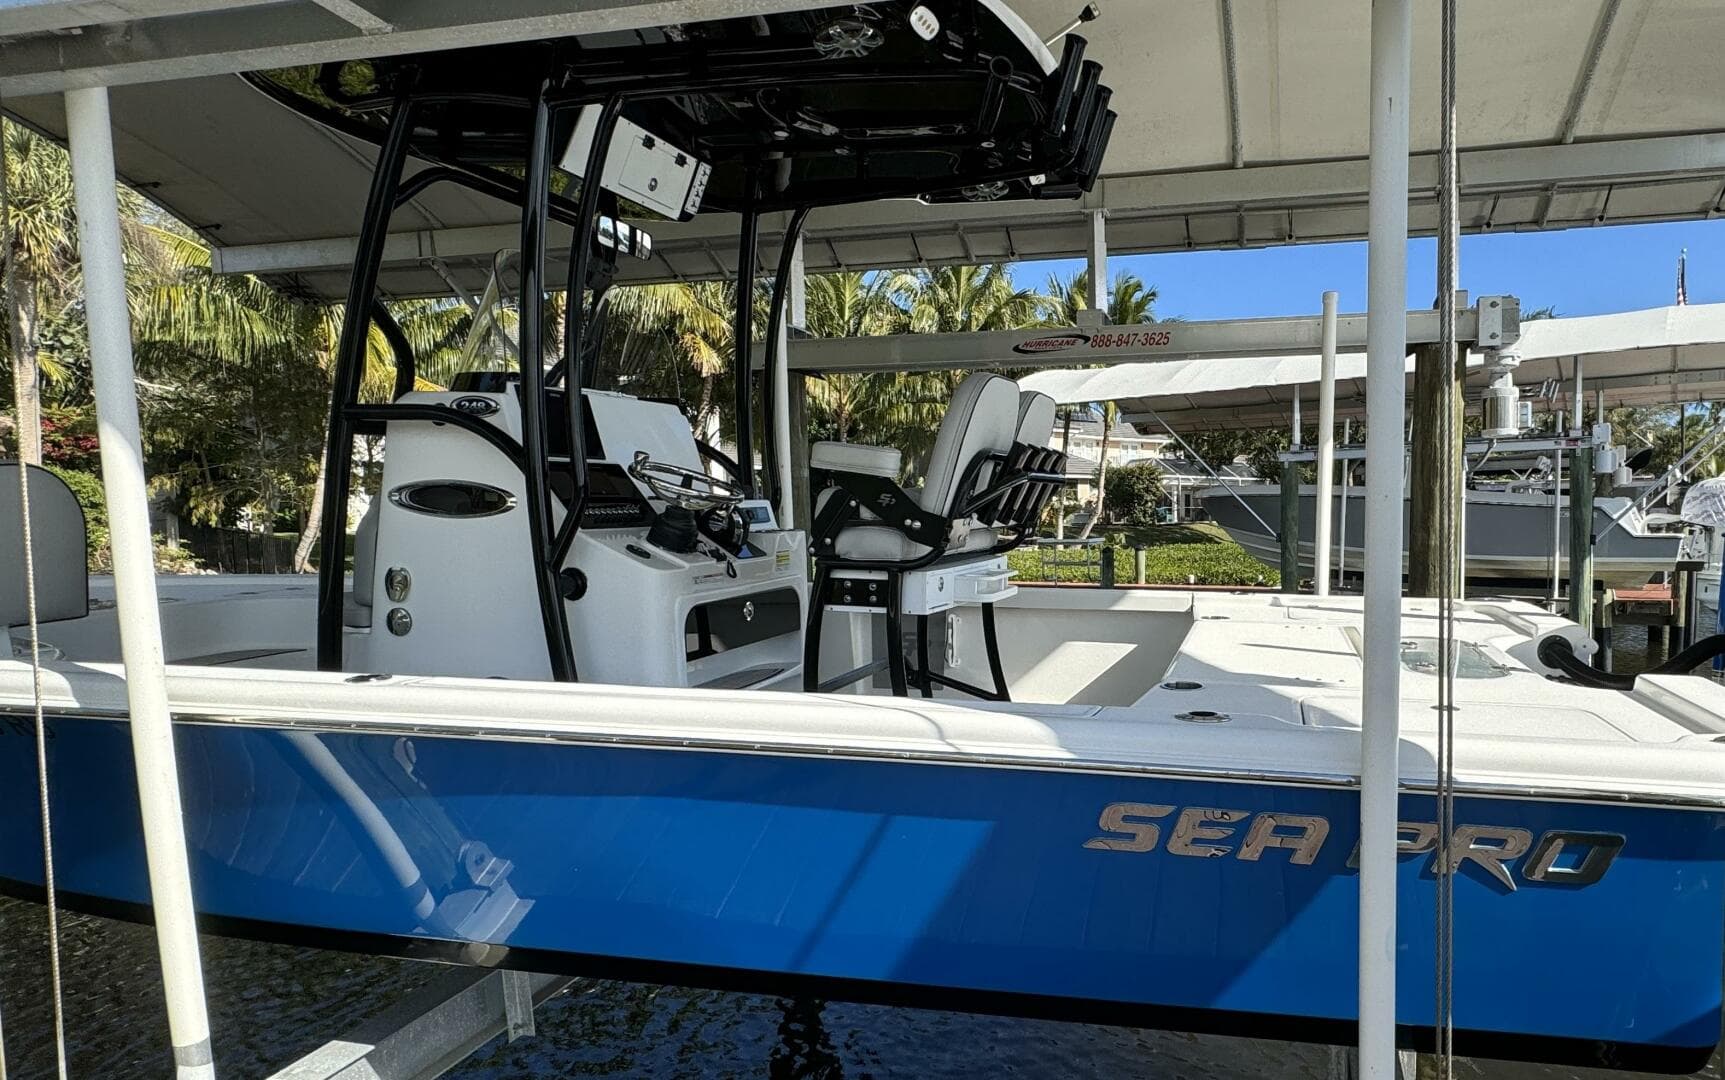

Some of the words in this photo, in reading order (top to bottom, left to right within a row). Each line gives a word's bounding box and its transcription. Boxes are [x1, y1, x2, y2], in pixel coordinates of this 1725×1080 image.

[1021, 338, 1079, 350] HURRICANE
[1090, 332, 1171, 348] 888-847-3625
[1082, 802, 1330, 866] SEA
